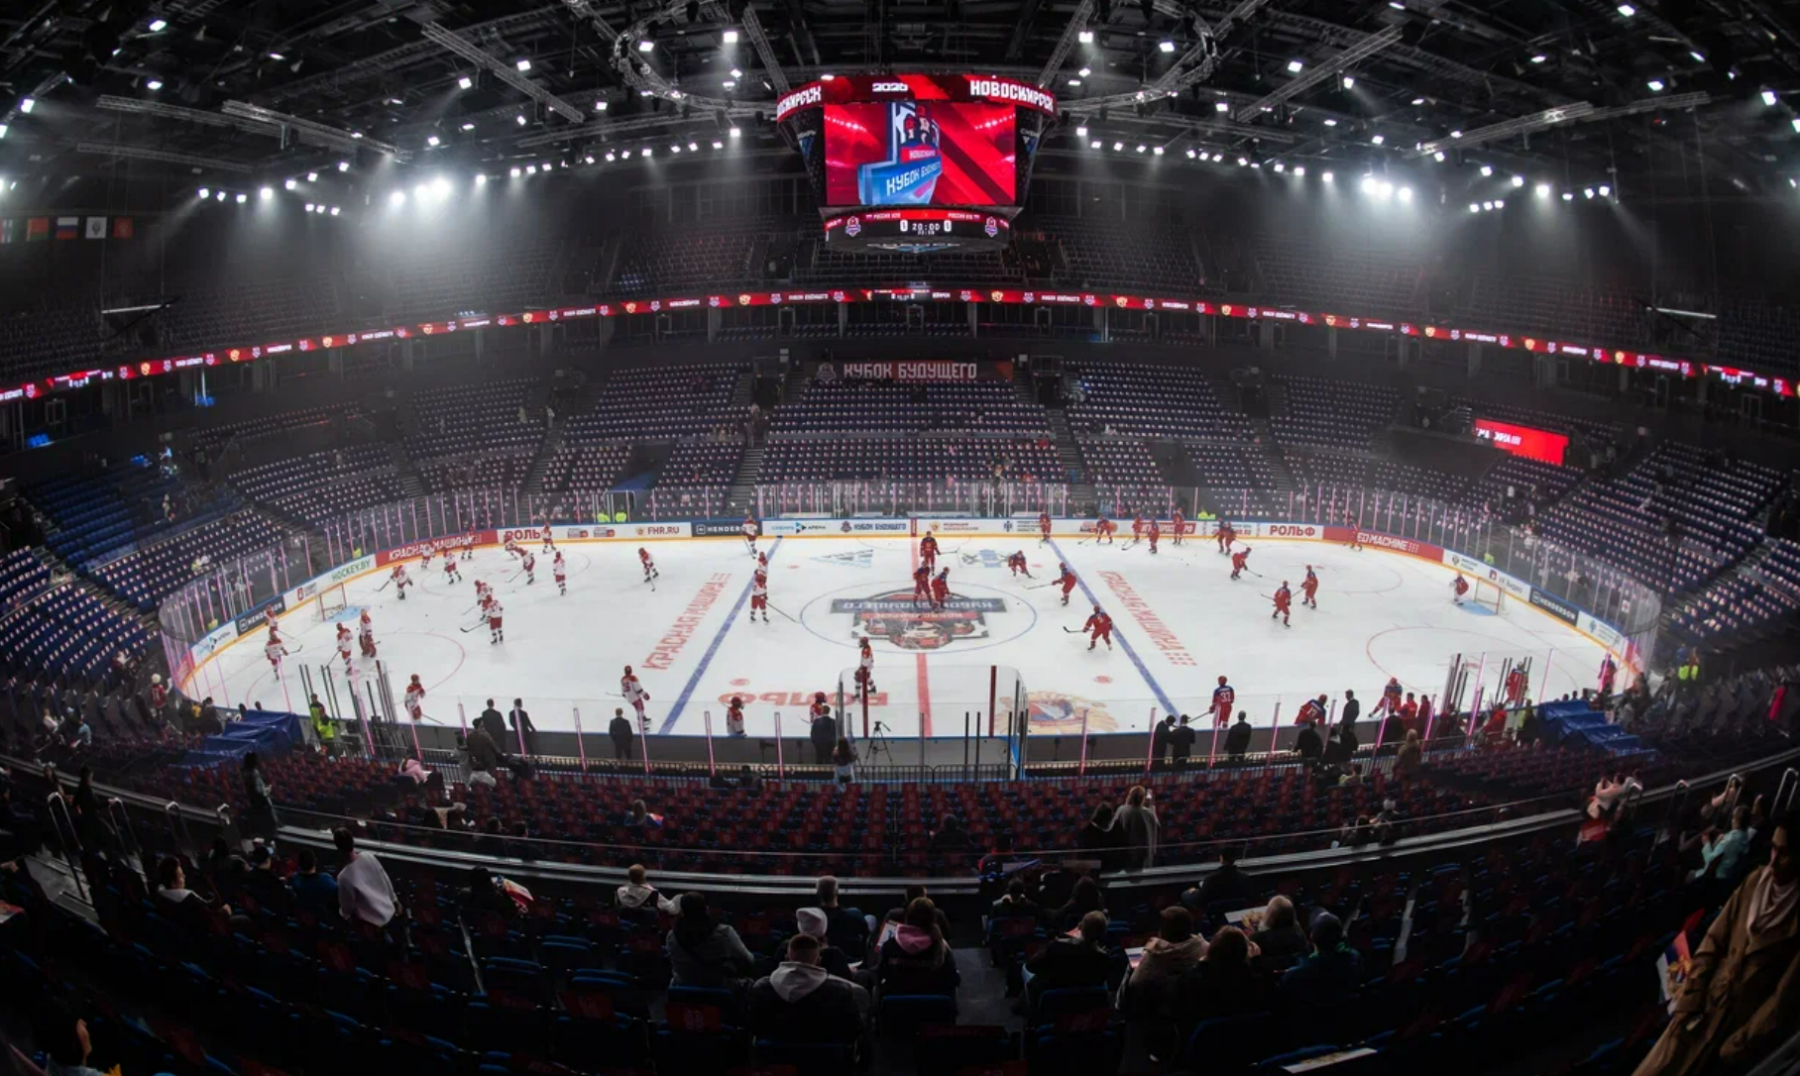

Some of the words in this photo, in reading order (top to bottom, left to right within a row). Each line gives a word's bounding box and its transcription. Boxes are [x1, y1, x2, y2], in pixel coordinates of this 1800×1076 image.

[900, 219, 909, 232] 0
[912, 223, 940, 231] 20:00
[943, 220, 952, 232] 0
[843, 363, 892, 379] КУБОК
[898, 363, 978, 380] БУДУЩЕГО
[647, 526, 680, 535] FHR.RU
[1269, 525, 1316, 537] РОЛЬФ
[1369, 533, 1409, 552] MACHINE
[331, 560, 371, 582] HOCKEY.BY
